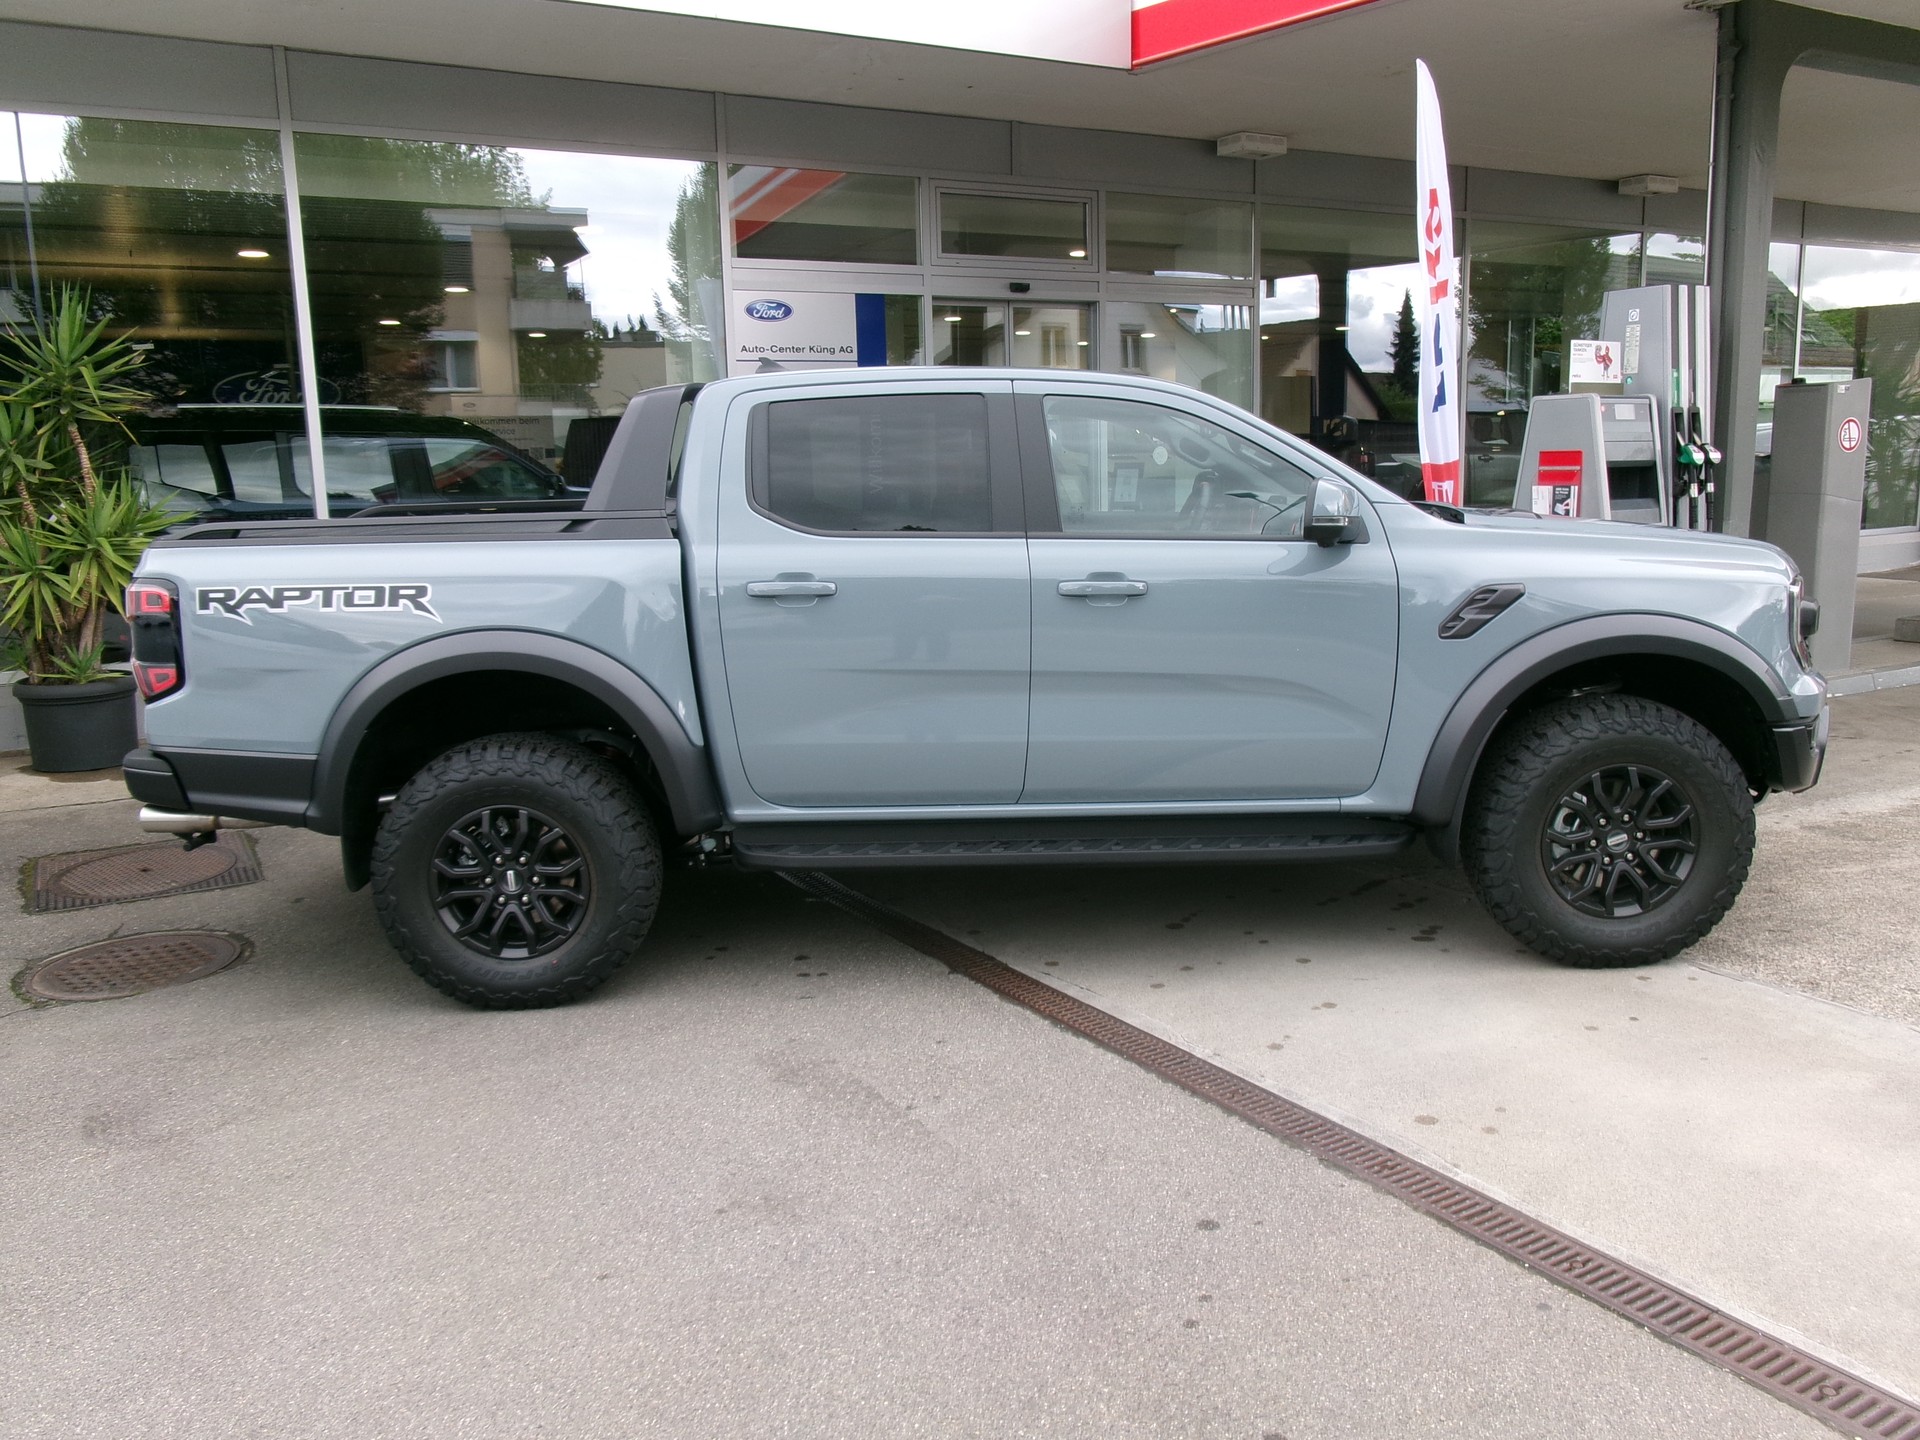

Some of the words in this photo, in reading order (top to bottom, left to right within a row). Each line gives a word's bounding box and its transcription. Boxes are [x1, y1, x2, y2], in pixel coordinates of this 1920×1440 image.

[752, 301, 786, 319] Ford
[740, 344, 806, 354] Auto-Center
[808, 344, 836, 356] Küng
[838, 345, 854, 354] AG
[518, 416, 539, 425] beim
[196, 583, 443, 627] RAPTOR
